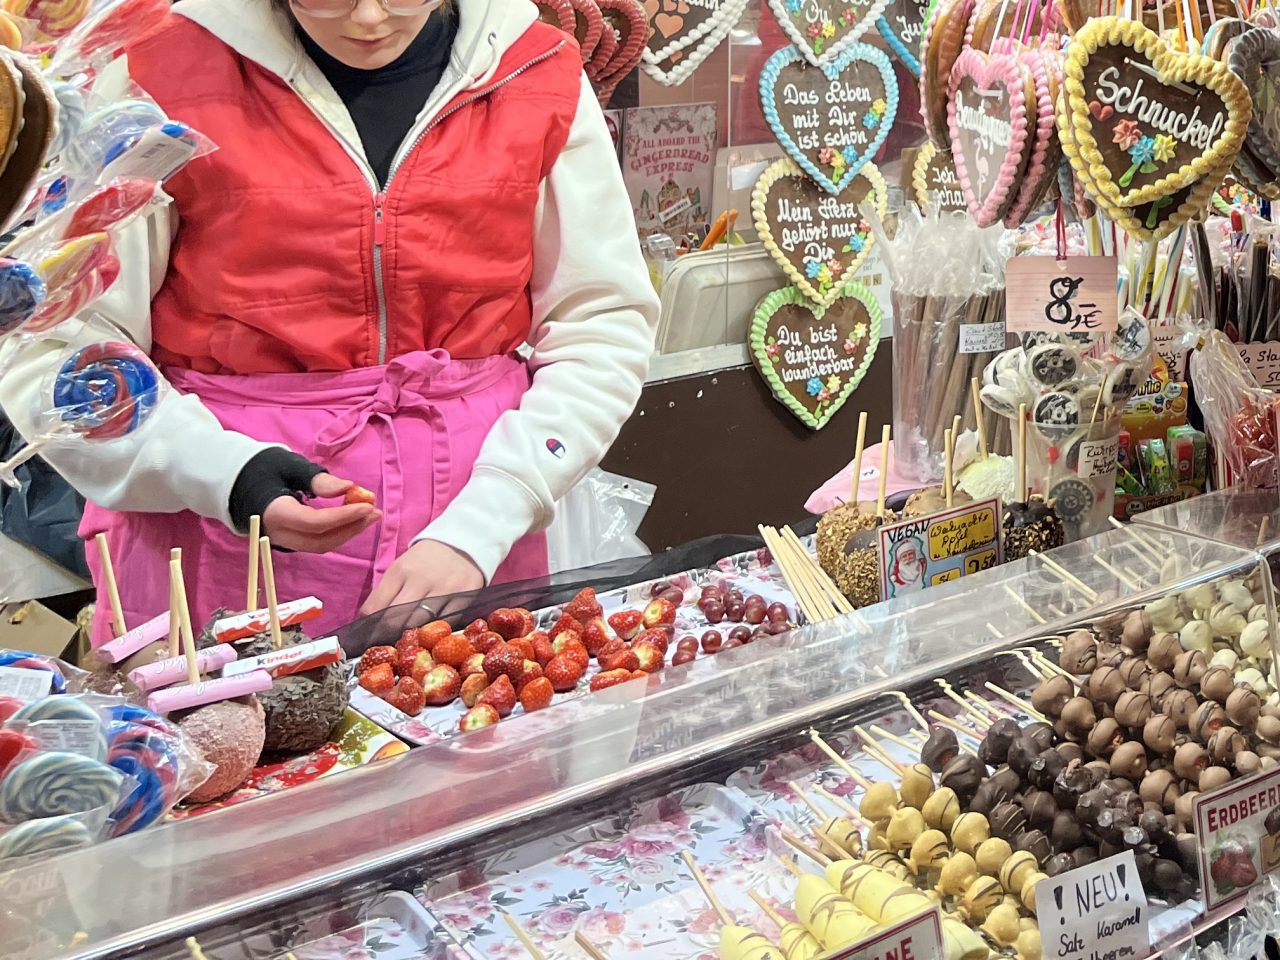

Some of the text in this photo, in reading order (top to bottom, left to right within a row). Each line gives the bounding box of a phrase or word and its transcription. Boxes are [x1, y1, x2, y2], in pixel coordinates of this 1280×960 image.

[783, 80, 872, 105] Das Leben
[793, 105, 857, 129] mit Dir
[1096, 66, 1223, 152] Schnuckel
[796, 126, 868, 150] ist schön
[645, 161, 695, 177] EXPRESS
[777, 197, 857, 223] Mein Herz
[782, 220, 858, 252] gehört nur
[803, 243, 836, 264] Dir
[777, 323, 838, 346] Du bist
[784, 344, 838, 369] einfach
[782, 356, 855, 384] wunderbar
[886, 519, 931, 543] VEGAN
[1096, 907, 1141, 939] Karamell
